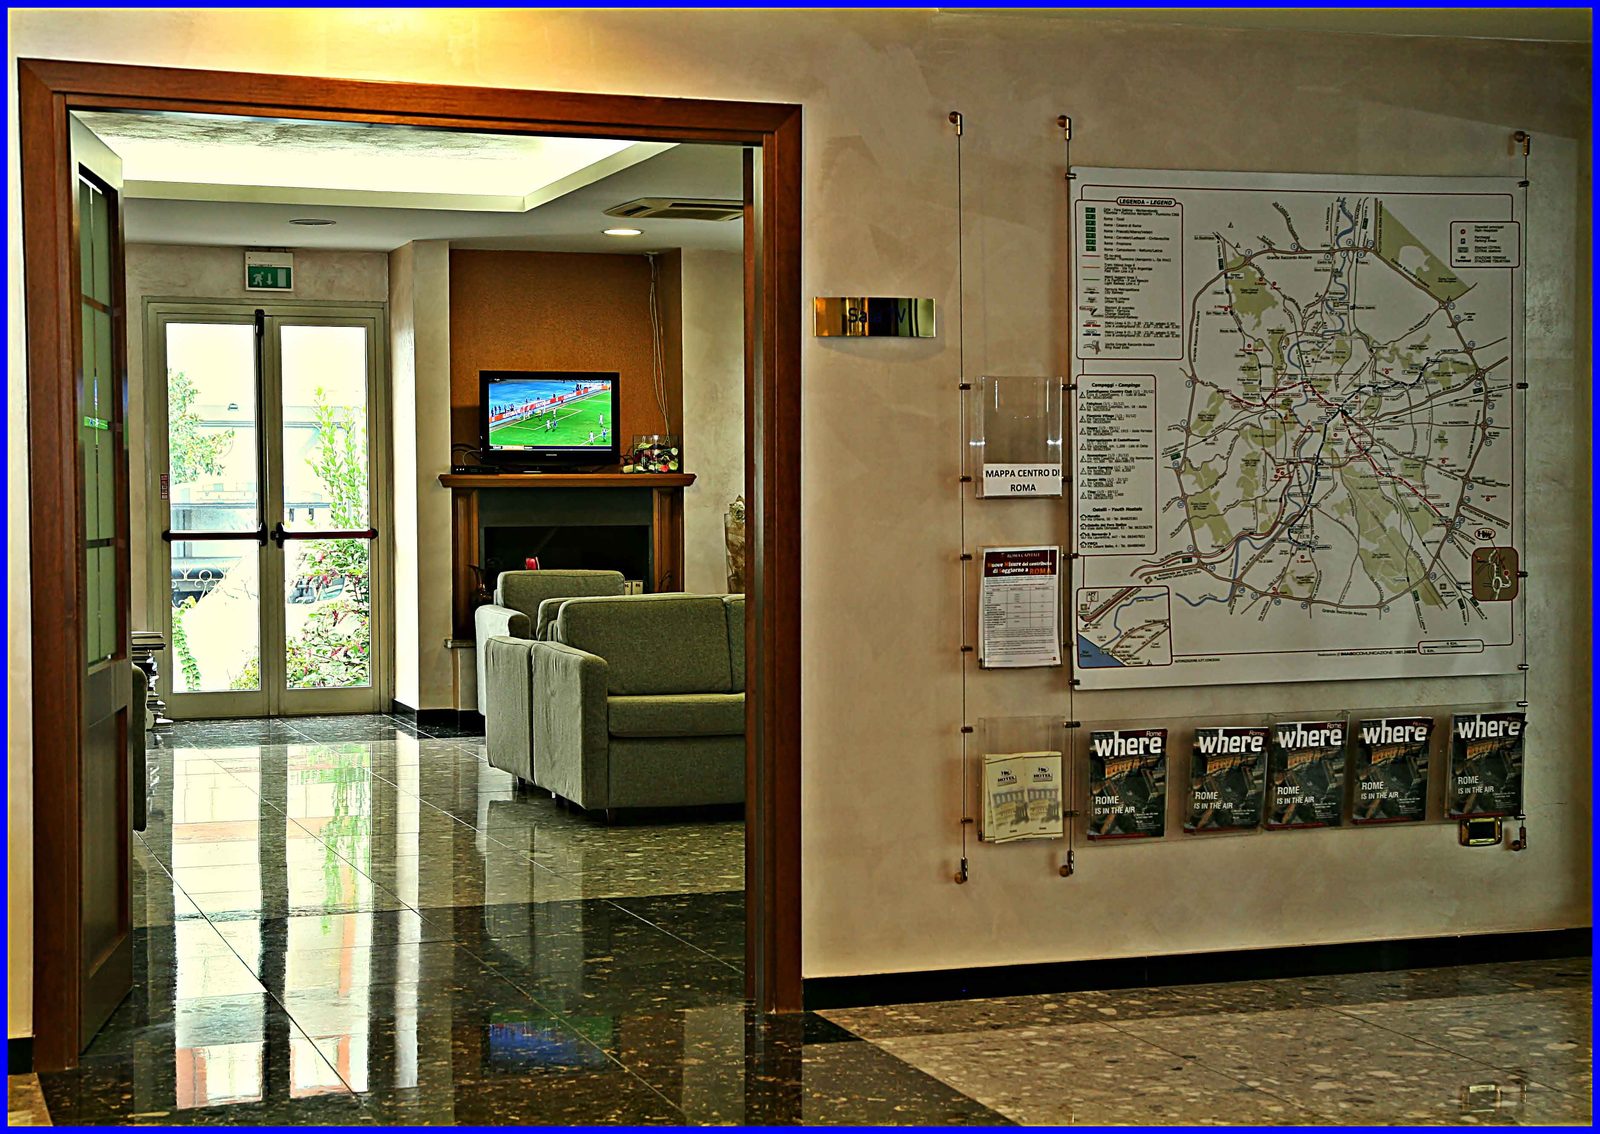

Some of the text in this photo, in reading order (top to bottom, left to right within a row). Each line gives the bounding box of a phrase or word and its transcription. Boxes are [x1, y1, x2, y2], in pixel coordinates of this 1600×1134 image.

[848, 307, 875, 323] Sa
[1017, 469, 1050, 477] CENTRO
[1051, 469, 1060, 477] DI
[1010, 484, 1037, 492] ROMA
[1458, 714, 1522, 739] where
[1277, 723, 1343, 749] where
[1363, 719, 1428, 745] where
[1094, 730, 1163, 757] where
[1198, 728, 1264, 754] where
[1457, 775, 1479, 785] ROME
[1361, 781, 1384, 790] ROME
[1471, 786, 1483, 794] THE
[1484, 785, 1495, 793] AIR
[1277, 786, 1300, 795] ROME
[1095, 795, 1120, 805] ROME
[1194, 791, 1219, 800] ROME
[1375, 792, 1388, 800] THE
[1388, 791, 1399, 799] AIR
[1284, 797, 1291, 805] IN
[1291, 797, 1304, 805] THE
[1304, 796, 1315, 804] AIR
[1102, 807, 1110, 815] IN
[1110, 806, 1124, 815] THE
[1124, 805, 1136, 814] AIR
[1194, 801, 1234, 810] IS IN THE AIR
